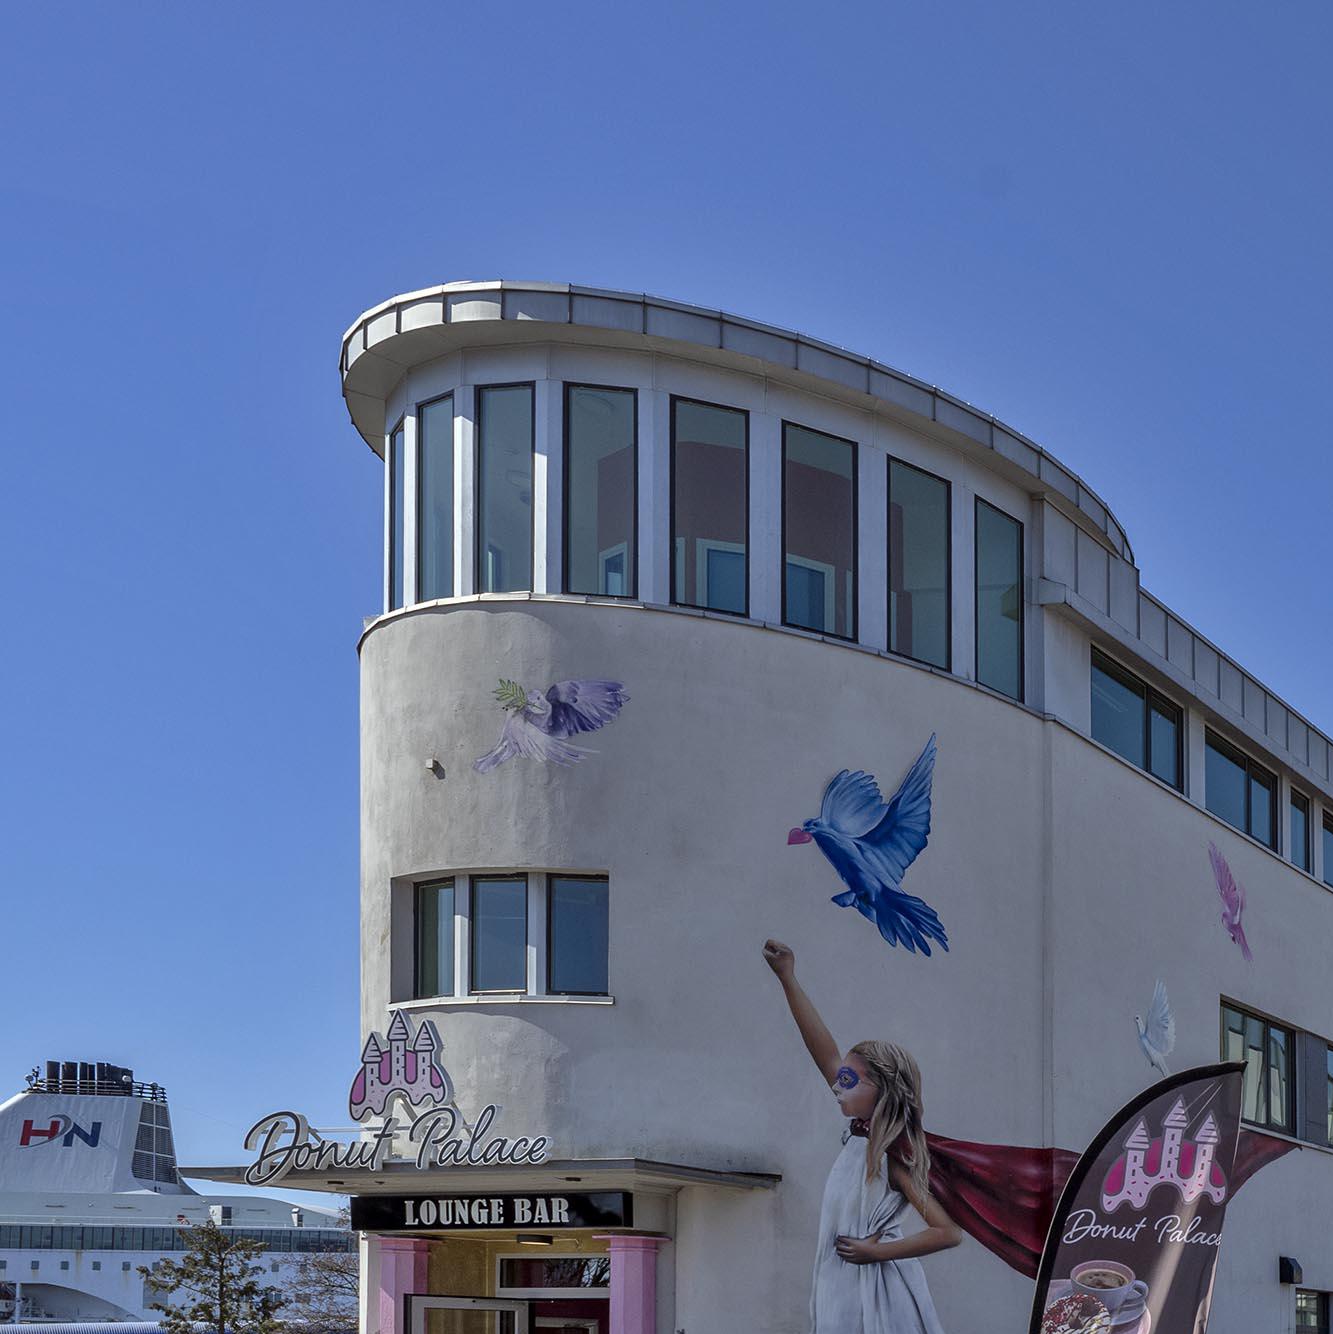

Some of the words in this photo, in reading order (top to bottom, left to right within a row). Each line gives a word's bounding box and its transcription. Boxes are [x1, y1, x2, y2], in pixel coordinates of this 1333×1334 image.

[244, 1110, 399, 1187] Donut
[408, 1103, 552, 1171] Palace
[404, 1199, 504, 1225] LOUNGE
[513, 1198, 570, 1224] BAR
[1062, 1208, 1147, 1244] Donut
